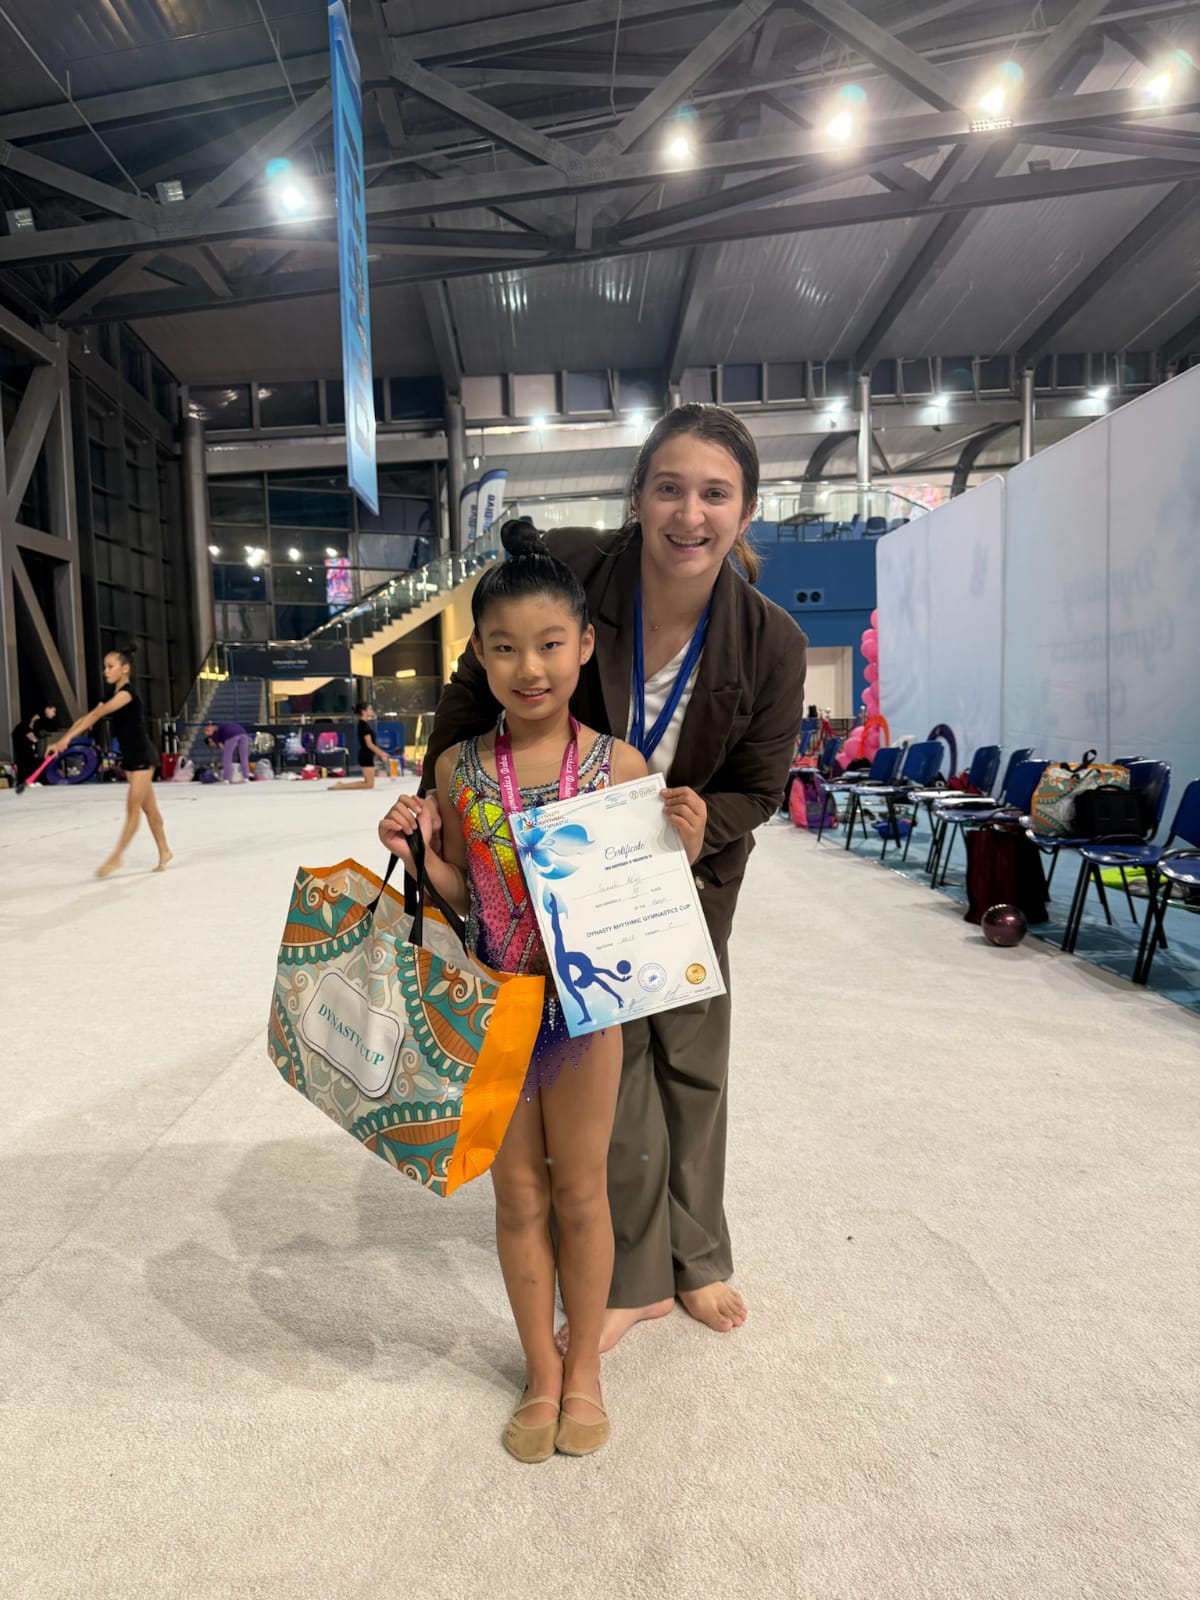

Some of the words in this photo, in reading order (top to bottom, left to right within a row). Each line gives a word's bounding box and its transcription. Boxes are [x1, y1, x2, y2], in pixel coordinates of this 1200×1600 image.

[604, 841, 646, 860] Certificate
[586, 924, 612, 938] DYNASTY
[613, 917, 642, 930] RHYTHMIC
[642, 906, 678, 922] GYMNASTICS
[679, 903, 691, 911] CUP
[318, 1003, 362, 1048] DYNASTY
[360, 1044, 384, 1065] CUP
